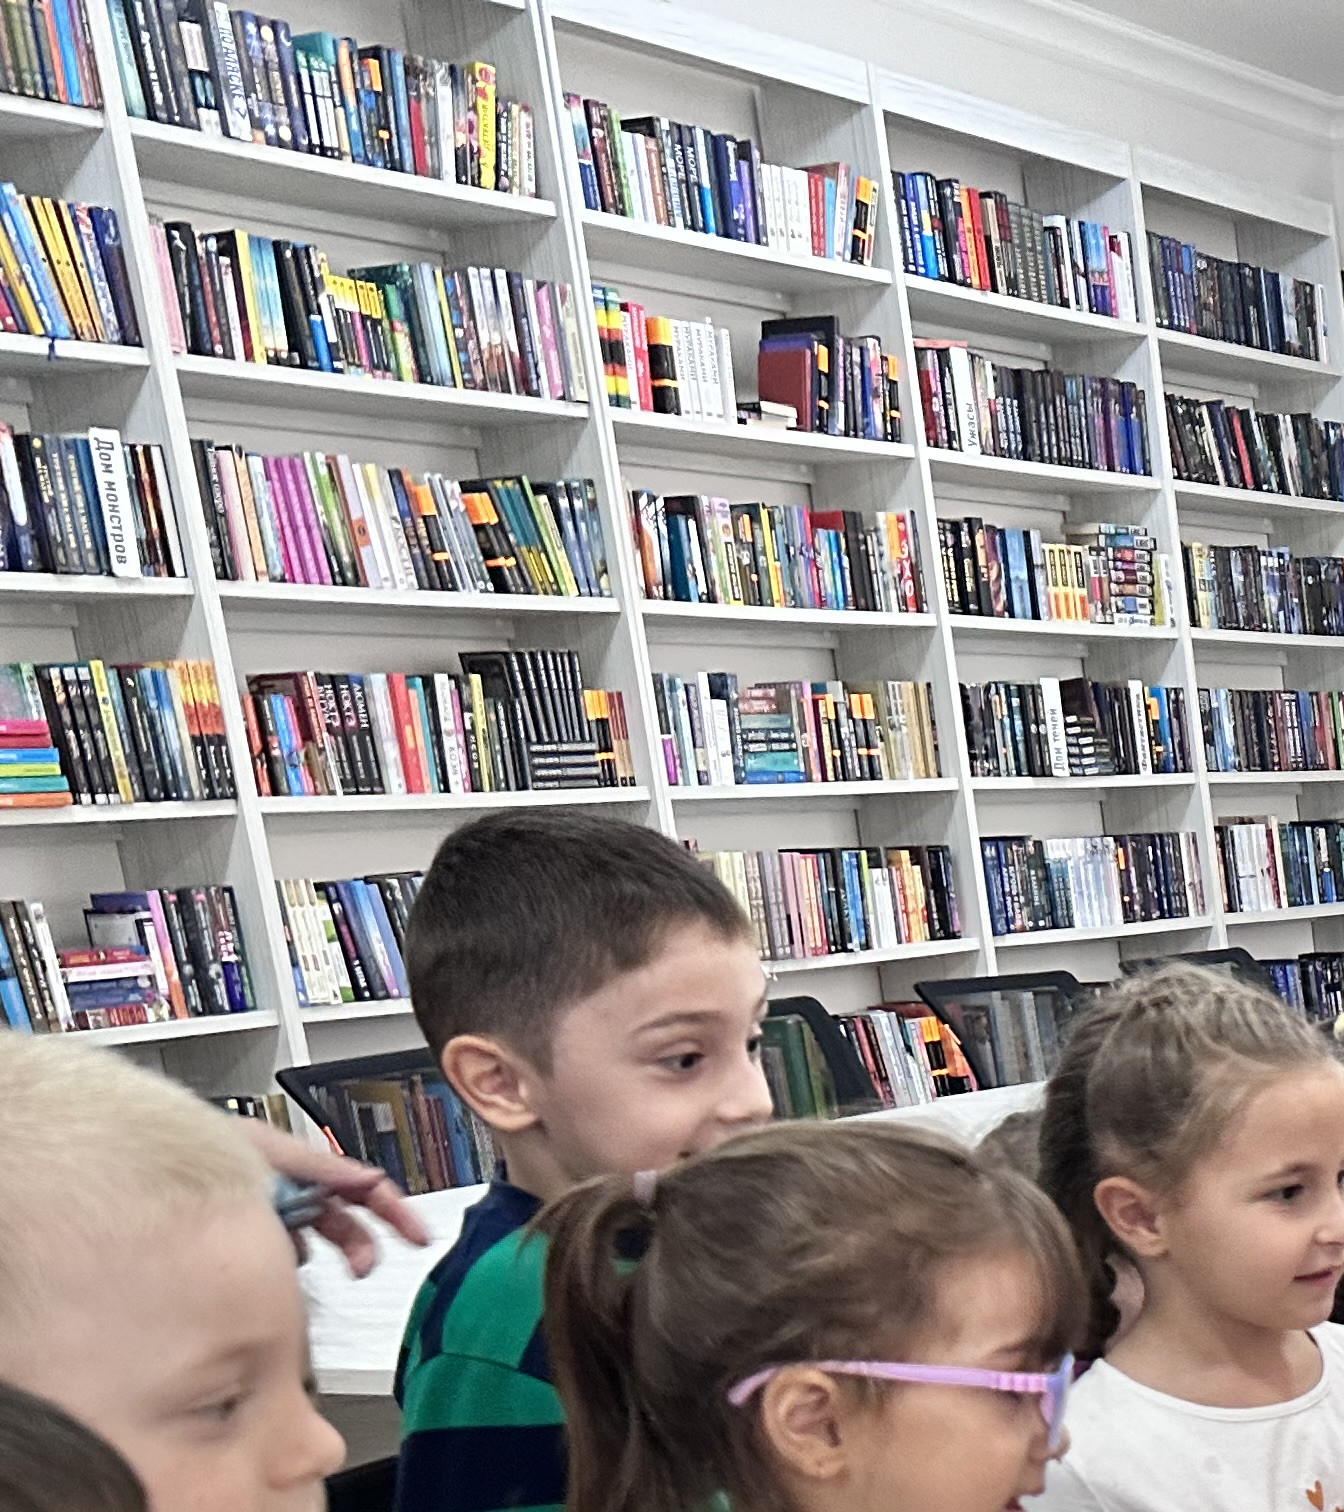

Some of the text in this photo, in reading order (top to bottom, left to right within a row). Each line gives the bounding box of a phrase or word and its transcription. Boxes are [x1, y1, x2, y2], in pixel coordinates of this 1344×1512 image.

[967, 402, 978, 448] Ужасы
[94, 437, 127, 565] Дом монстров
[1047, 708, 1068, 772] Дом теней
